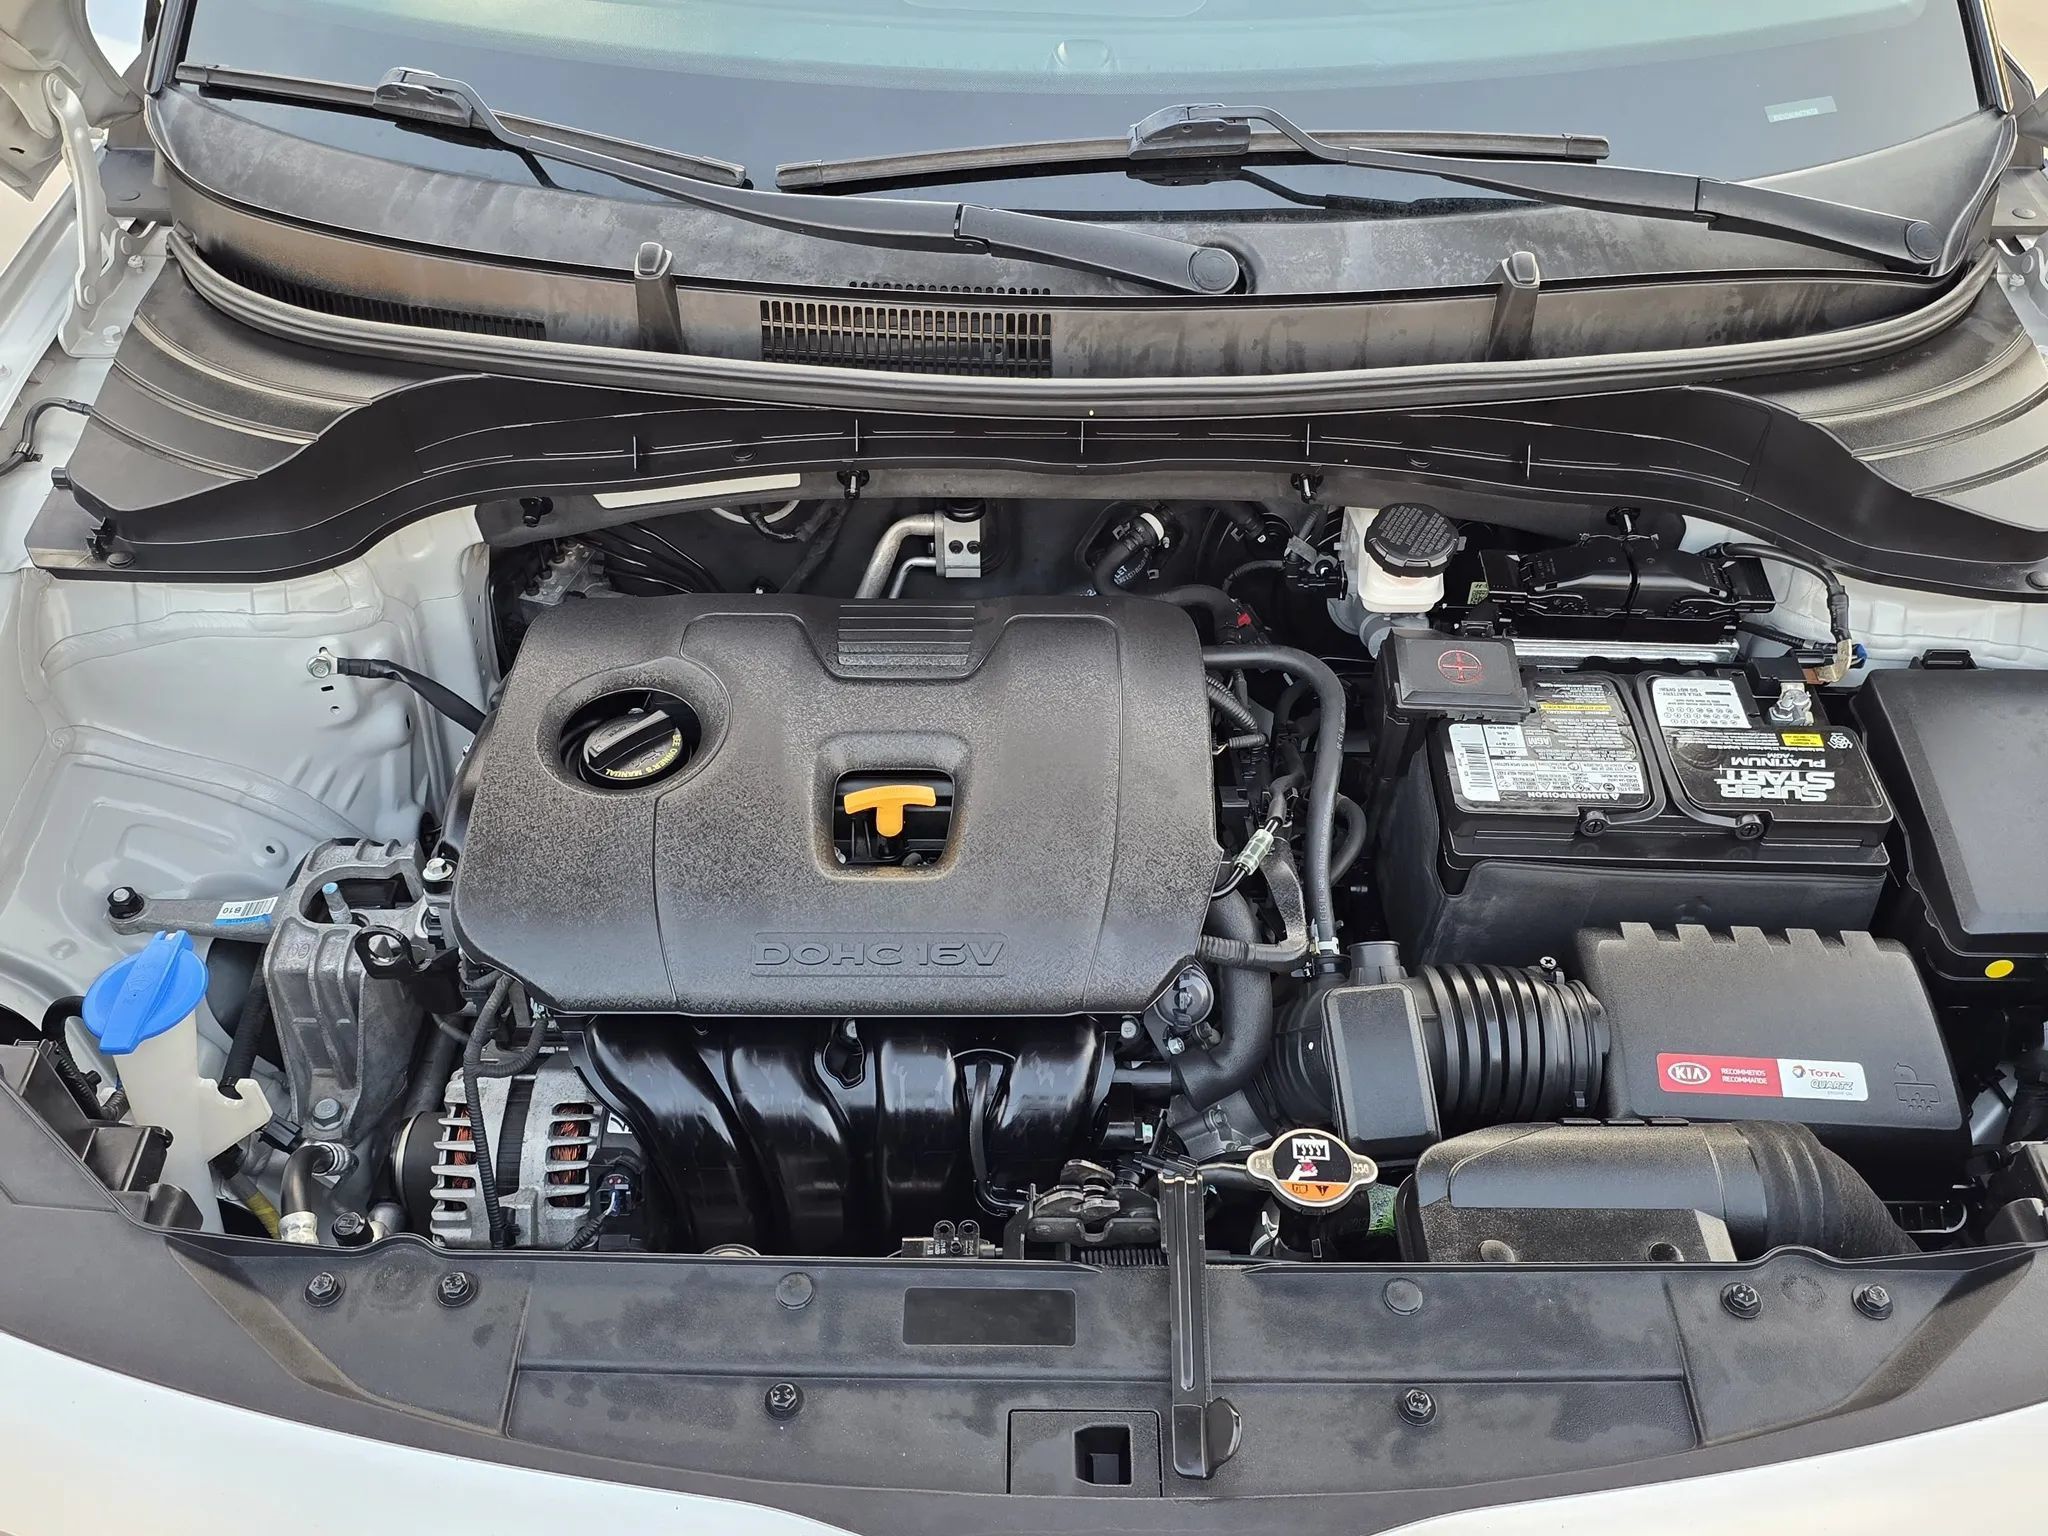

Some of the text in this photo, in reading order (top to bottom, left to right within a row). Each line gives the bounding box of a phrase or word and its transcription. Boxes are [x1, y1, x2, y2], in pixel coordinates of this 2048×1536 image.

[672, 734, 682, 747] SEE
[1731, 756, 1826, 769] PLATINUM
[605, 768, 643, 778] MANUAL
[1714, 770, 1835, 790] START
[1527, 791, 1610, 800] DANGER/POISON
[1720, 784, 1827, 802] SUPER
[222, 906, 242, 914] B10
[755, 942, 1004, 966] DOHC 16V
[1674, 1066, 1705, 1081] KIA
[1808, 1067, 1846, 1078] TOTAL
[1810, 1079, 1854, 1091] QUARTZ
